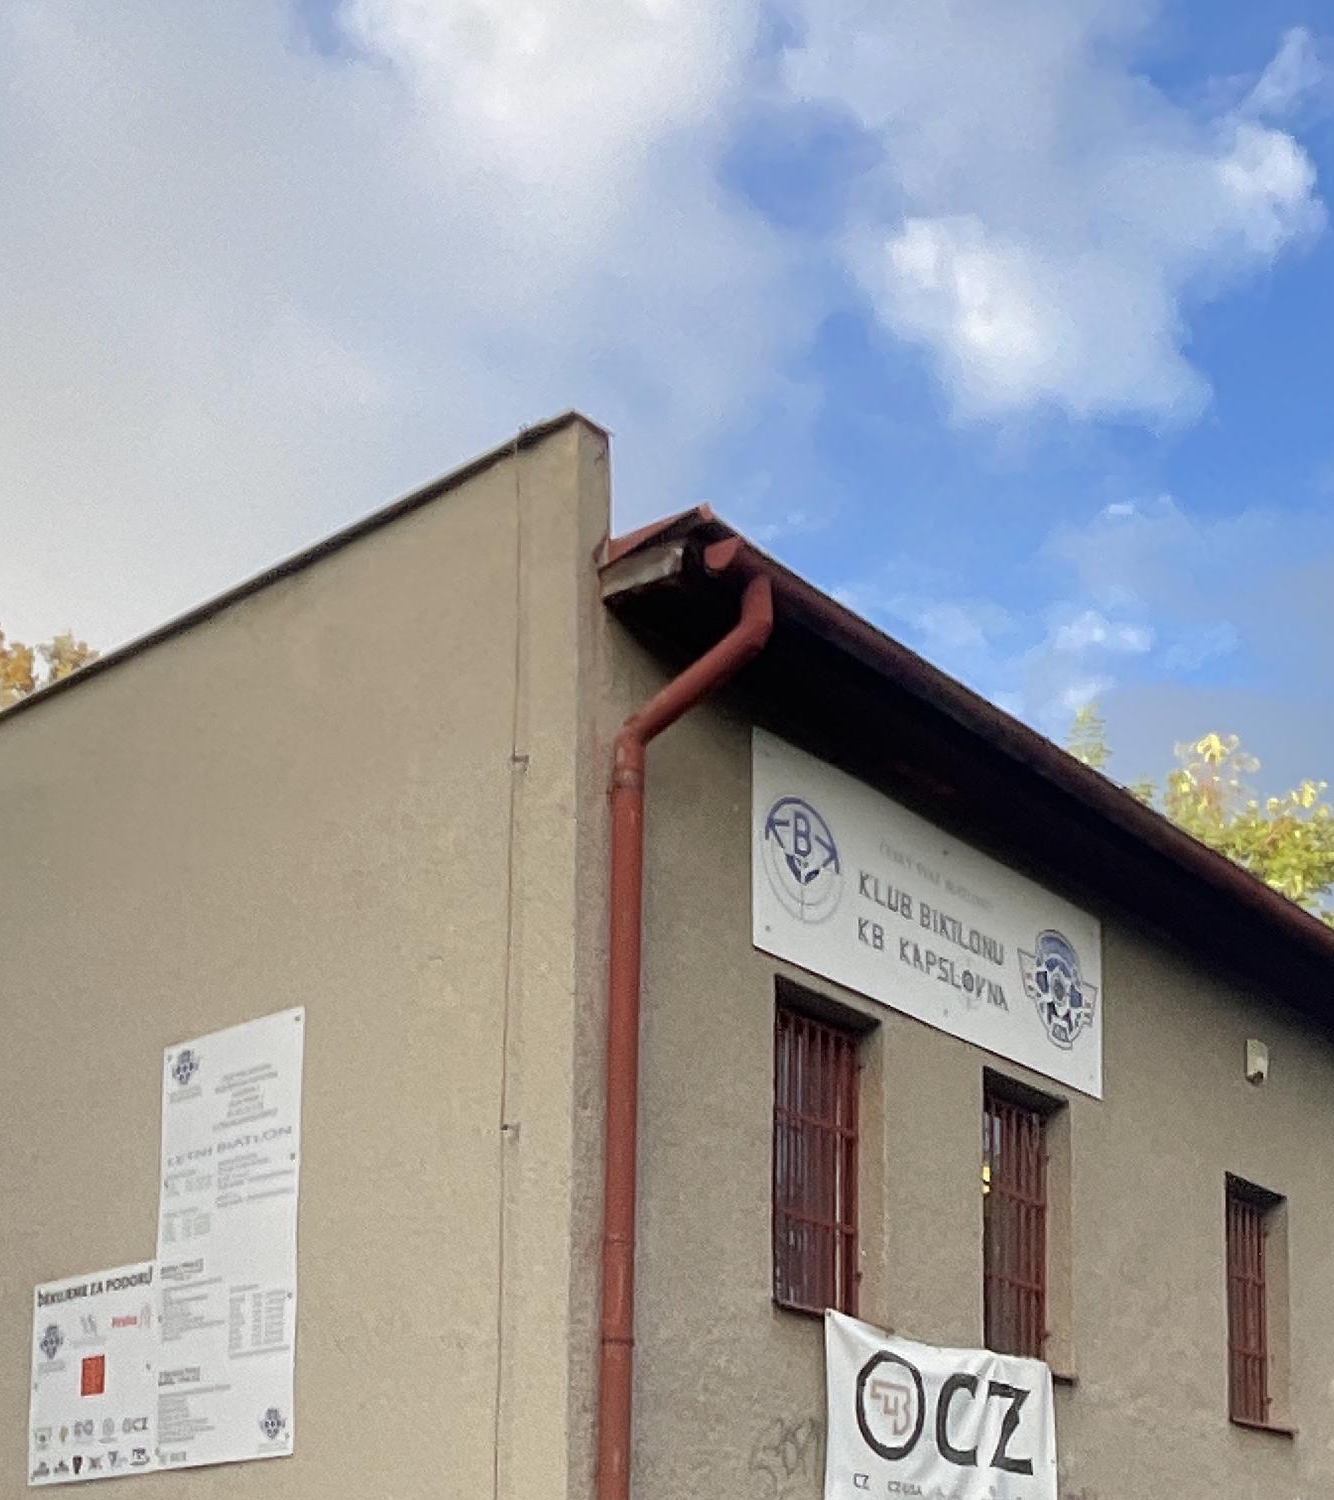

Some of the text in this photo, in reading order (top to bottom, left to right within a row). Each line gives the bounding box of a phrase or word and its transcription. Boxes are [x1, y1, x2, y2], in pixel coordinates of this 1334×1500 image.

[859, 871, 913, 920] KLUB
[858, 917, 1008, 1011] KB KAPSLOVNA
[853, 1472, 870, 1491] CZ
